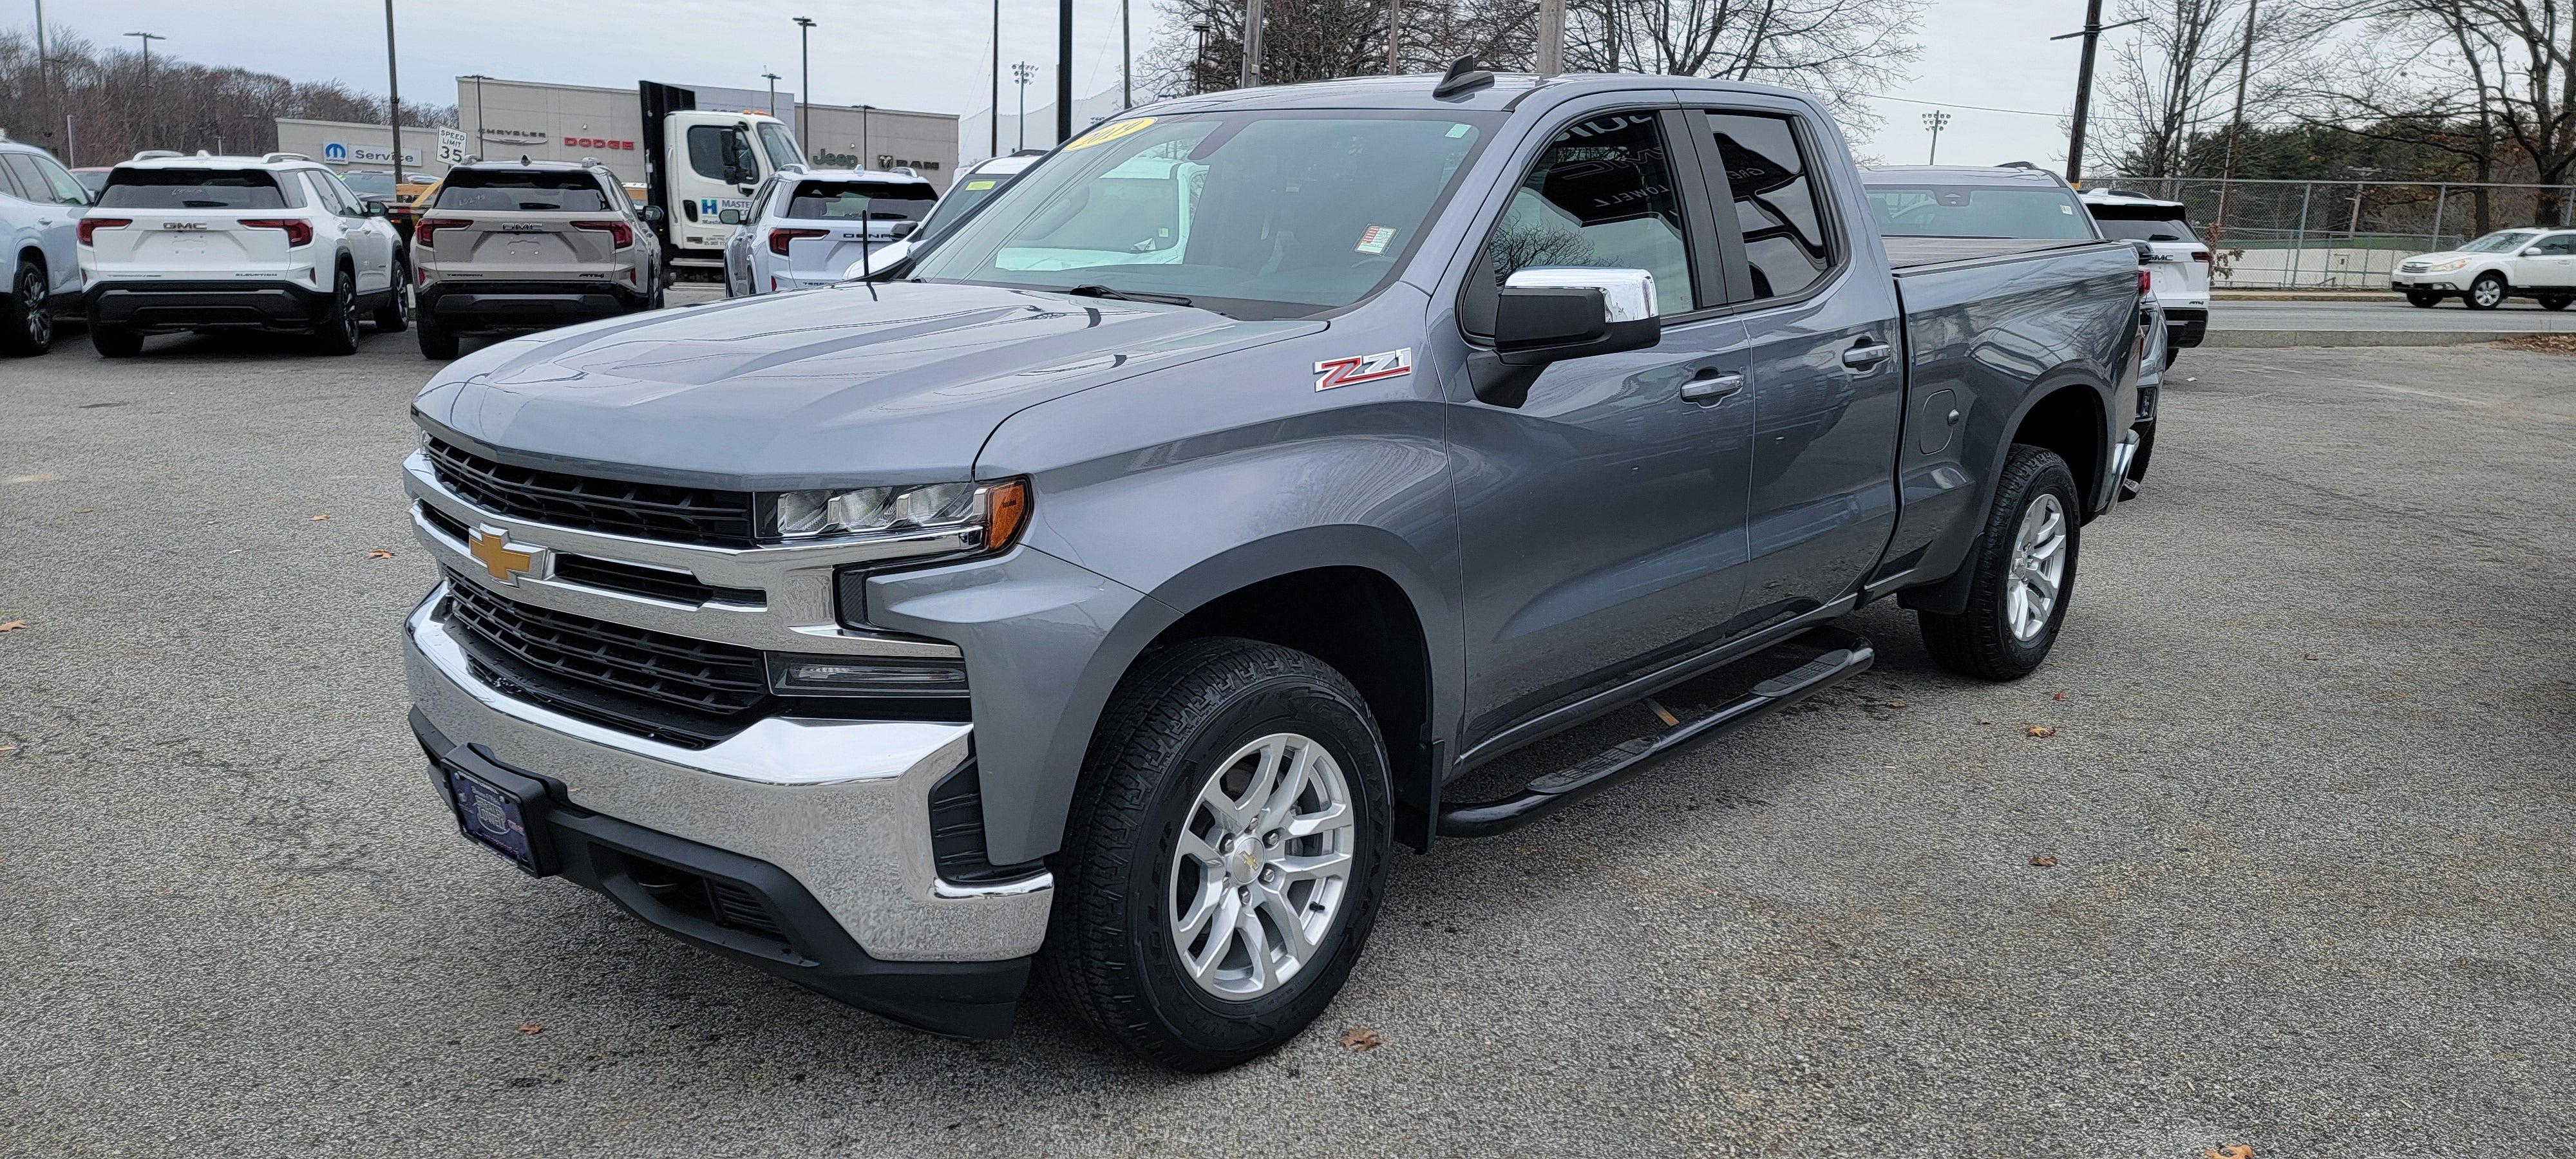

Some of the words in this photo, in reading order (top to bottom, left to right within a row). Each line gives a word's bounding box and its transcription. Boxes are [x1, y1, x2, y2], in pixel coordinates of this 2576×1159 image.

[440, 130, 465, 142] SPEED
[442, 138, 462, 148] LIMIT
[564, 137, 634, 150] DODGE
[440, 146, 463, 162] 35
[813, 148, 858, 167] Jeep
[896, 160, 940, 170] RAM
[722, 200, 752, 208] MASTE
[1312, 346, 1412, 393] Z71
